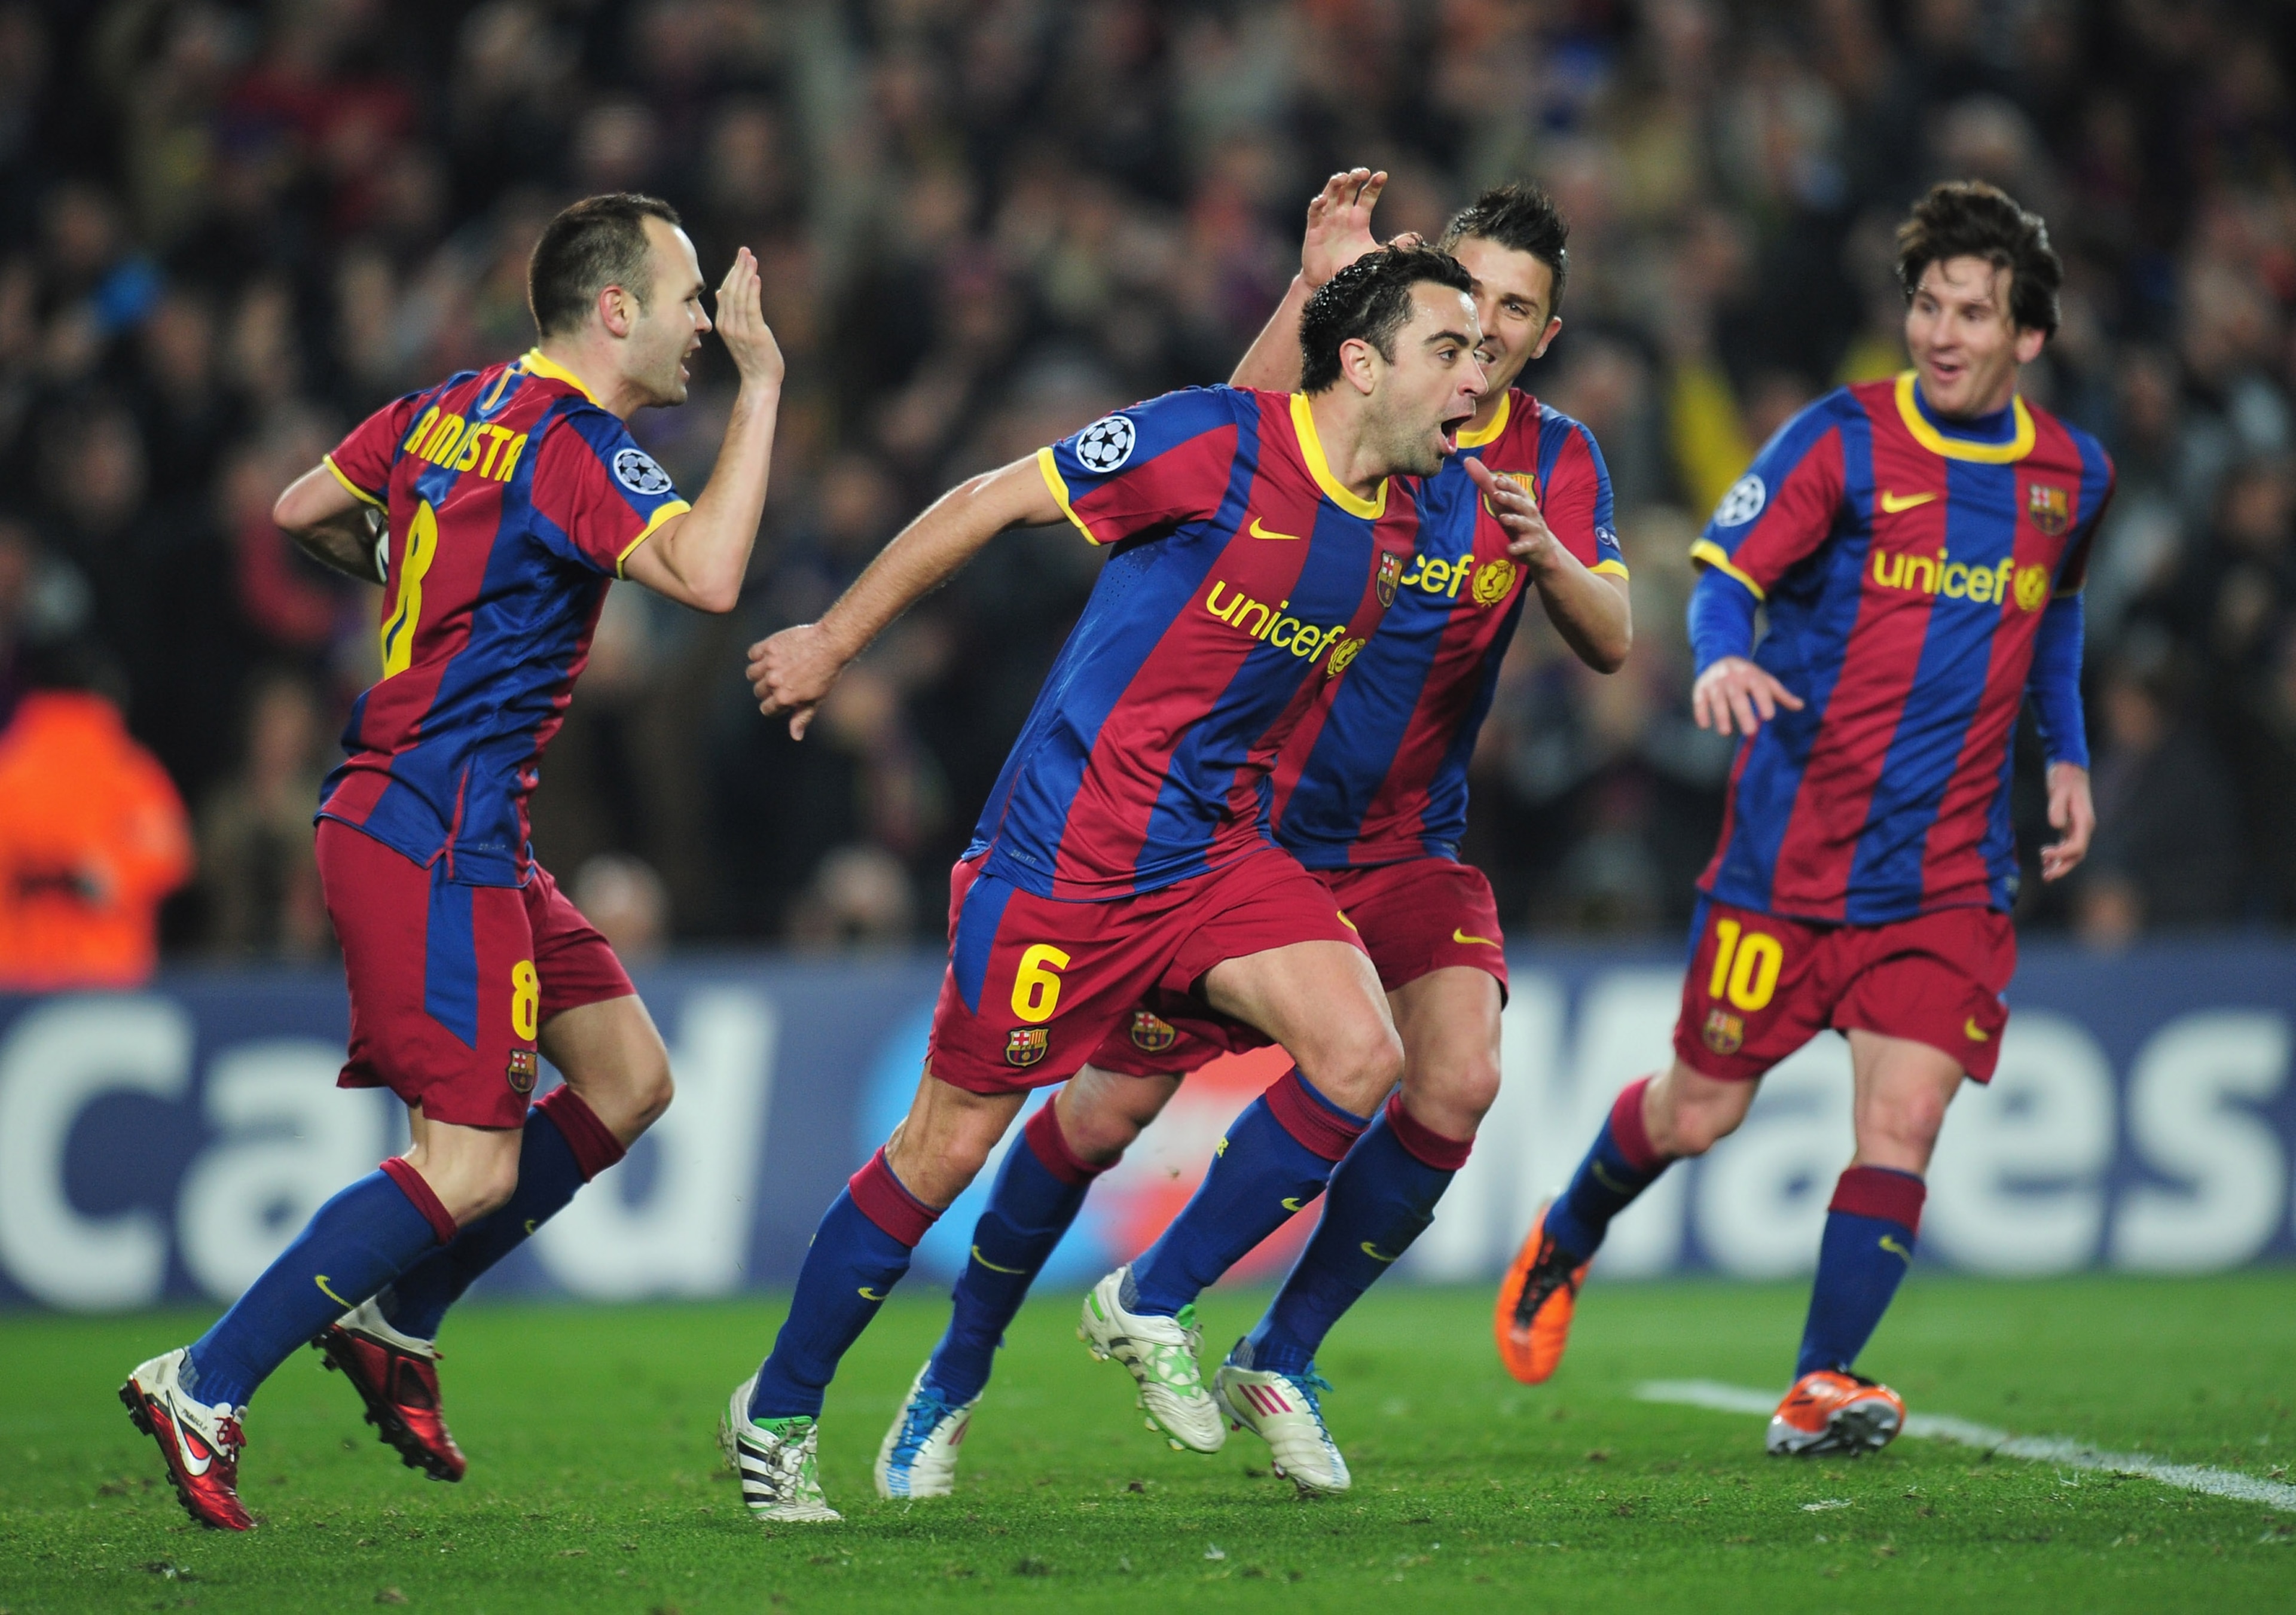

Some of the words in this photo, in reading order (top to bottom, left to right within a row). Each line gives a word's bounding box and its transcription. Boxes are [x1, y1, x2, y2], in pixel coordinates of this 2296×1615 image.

[381, 499, 438, 681] 8
[1873, 547, 2015, 606] unicef
[1206, 580, 1346, 663] unicef
[511, 960, 538, 1041] 8
[1010, 944, 1071, 1022] 6
[1708, 917, 1784, 1012] 10
[0, 985, 778, 1311] Cad
[1432, 967, 2296, 1281] Maes
